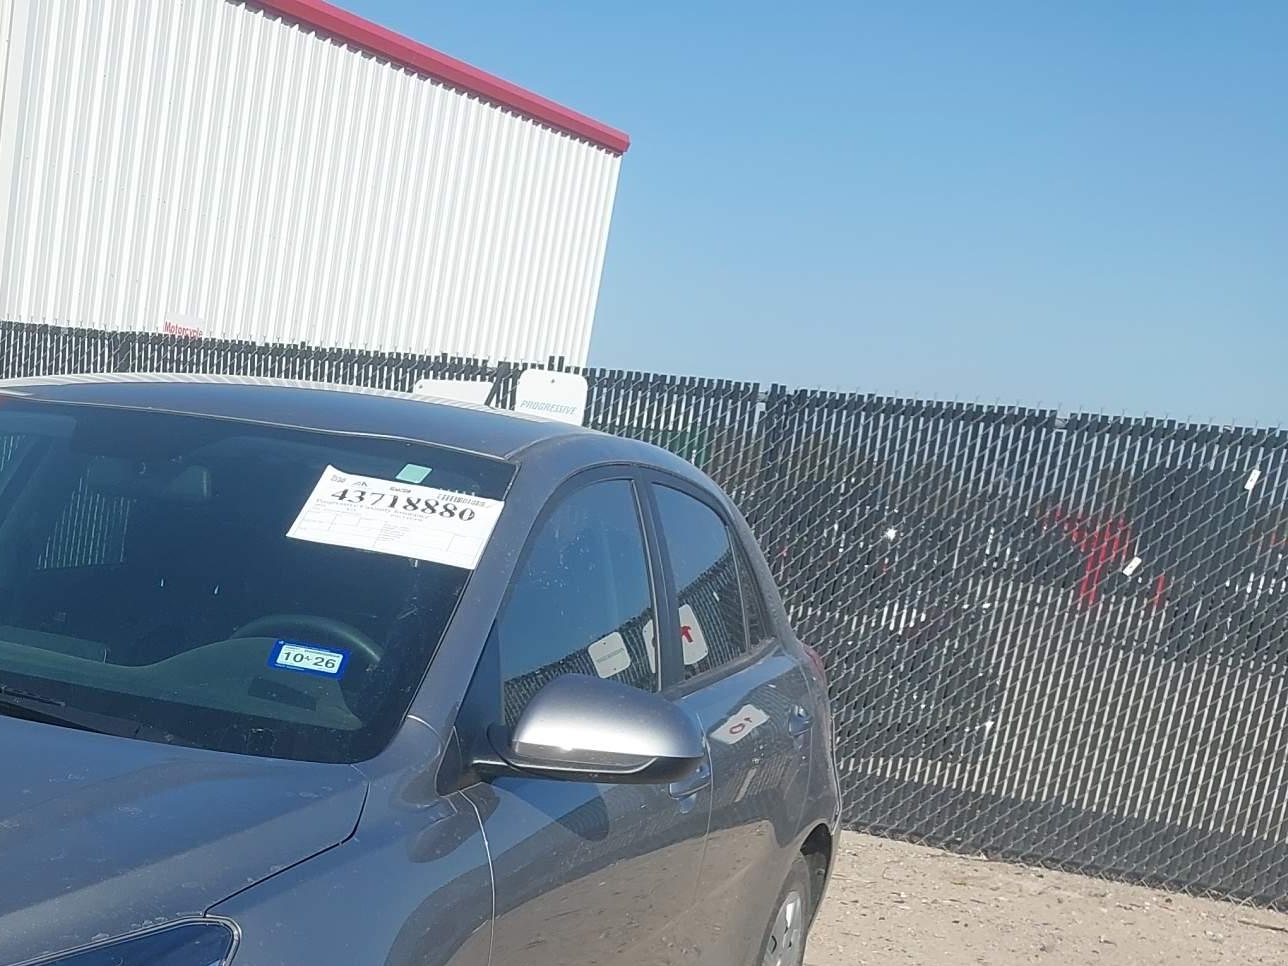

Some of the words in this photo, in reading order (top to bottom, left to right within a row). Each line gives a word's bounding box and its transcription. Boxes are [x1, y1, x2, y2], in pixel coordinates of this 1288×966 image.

[520, 400, 578, 416] PROGRESSIVE
[330, 488, 476, 522] 43718880
[313, 656, 337, 669] 26
